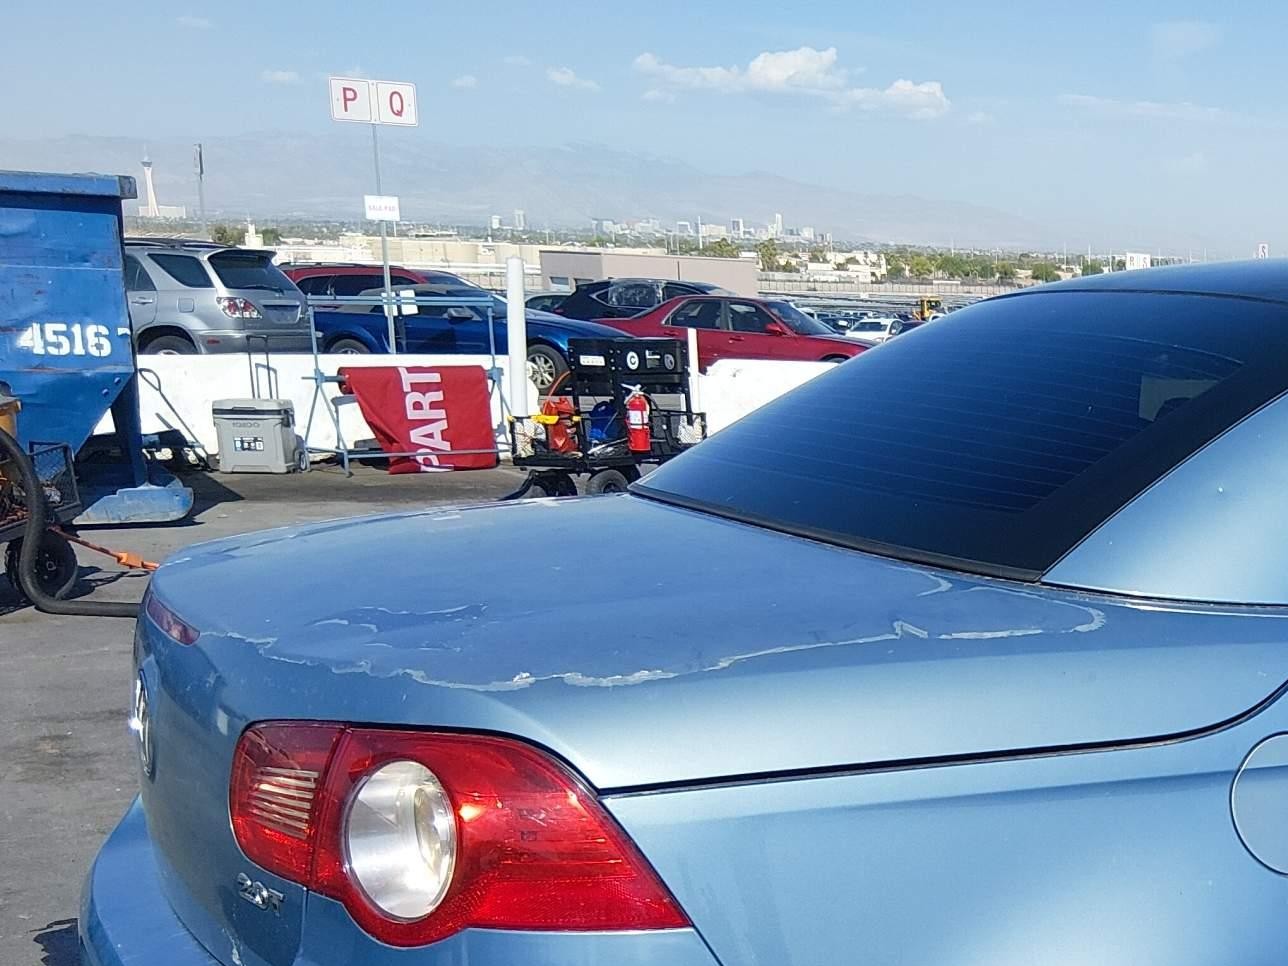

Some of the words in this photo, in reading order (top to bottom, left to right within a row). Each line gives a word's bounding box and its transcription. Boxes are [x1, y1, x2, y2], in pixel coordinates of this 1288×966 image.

[342, 87, 358, 112] P
[389, 91, 404, 117] Q
[16, 322, 112, 357] 4516
[398, 367, 455, 473] PART
